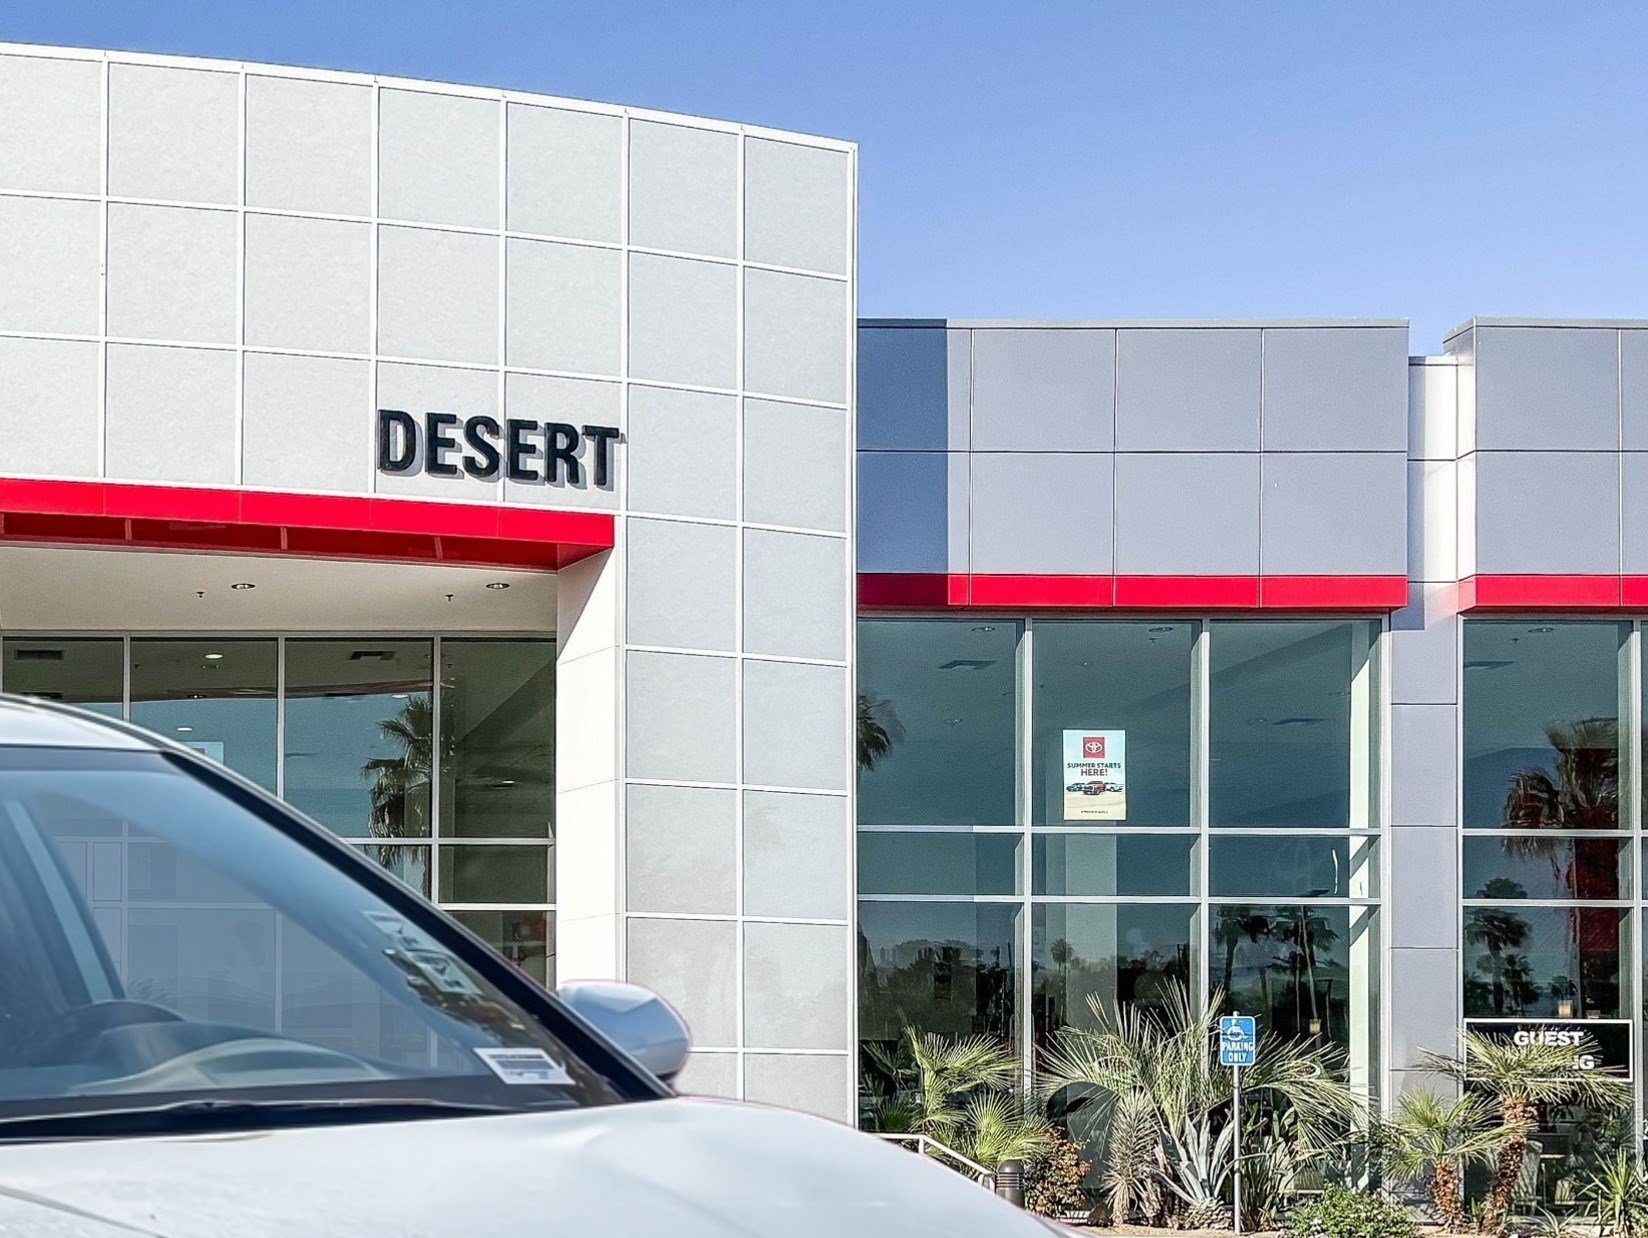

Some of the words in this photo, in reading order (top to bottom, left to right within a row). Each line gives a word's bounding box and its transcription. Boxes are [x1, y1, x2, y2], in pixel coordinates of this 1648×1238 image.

[376, 408, 620, 487] DESERT
[1080, 768, 1108, 776] HERE!
[1513, 1030, 1584, 1047] GUEST
[1222, 1041, 1254, 1052] PARKING
[1228, 1052, 1247, 1063] ONLY
